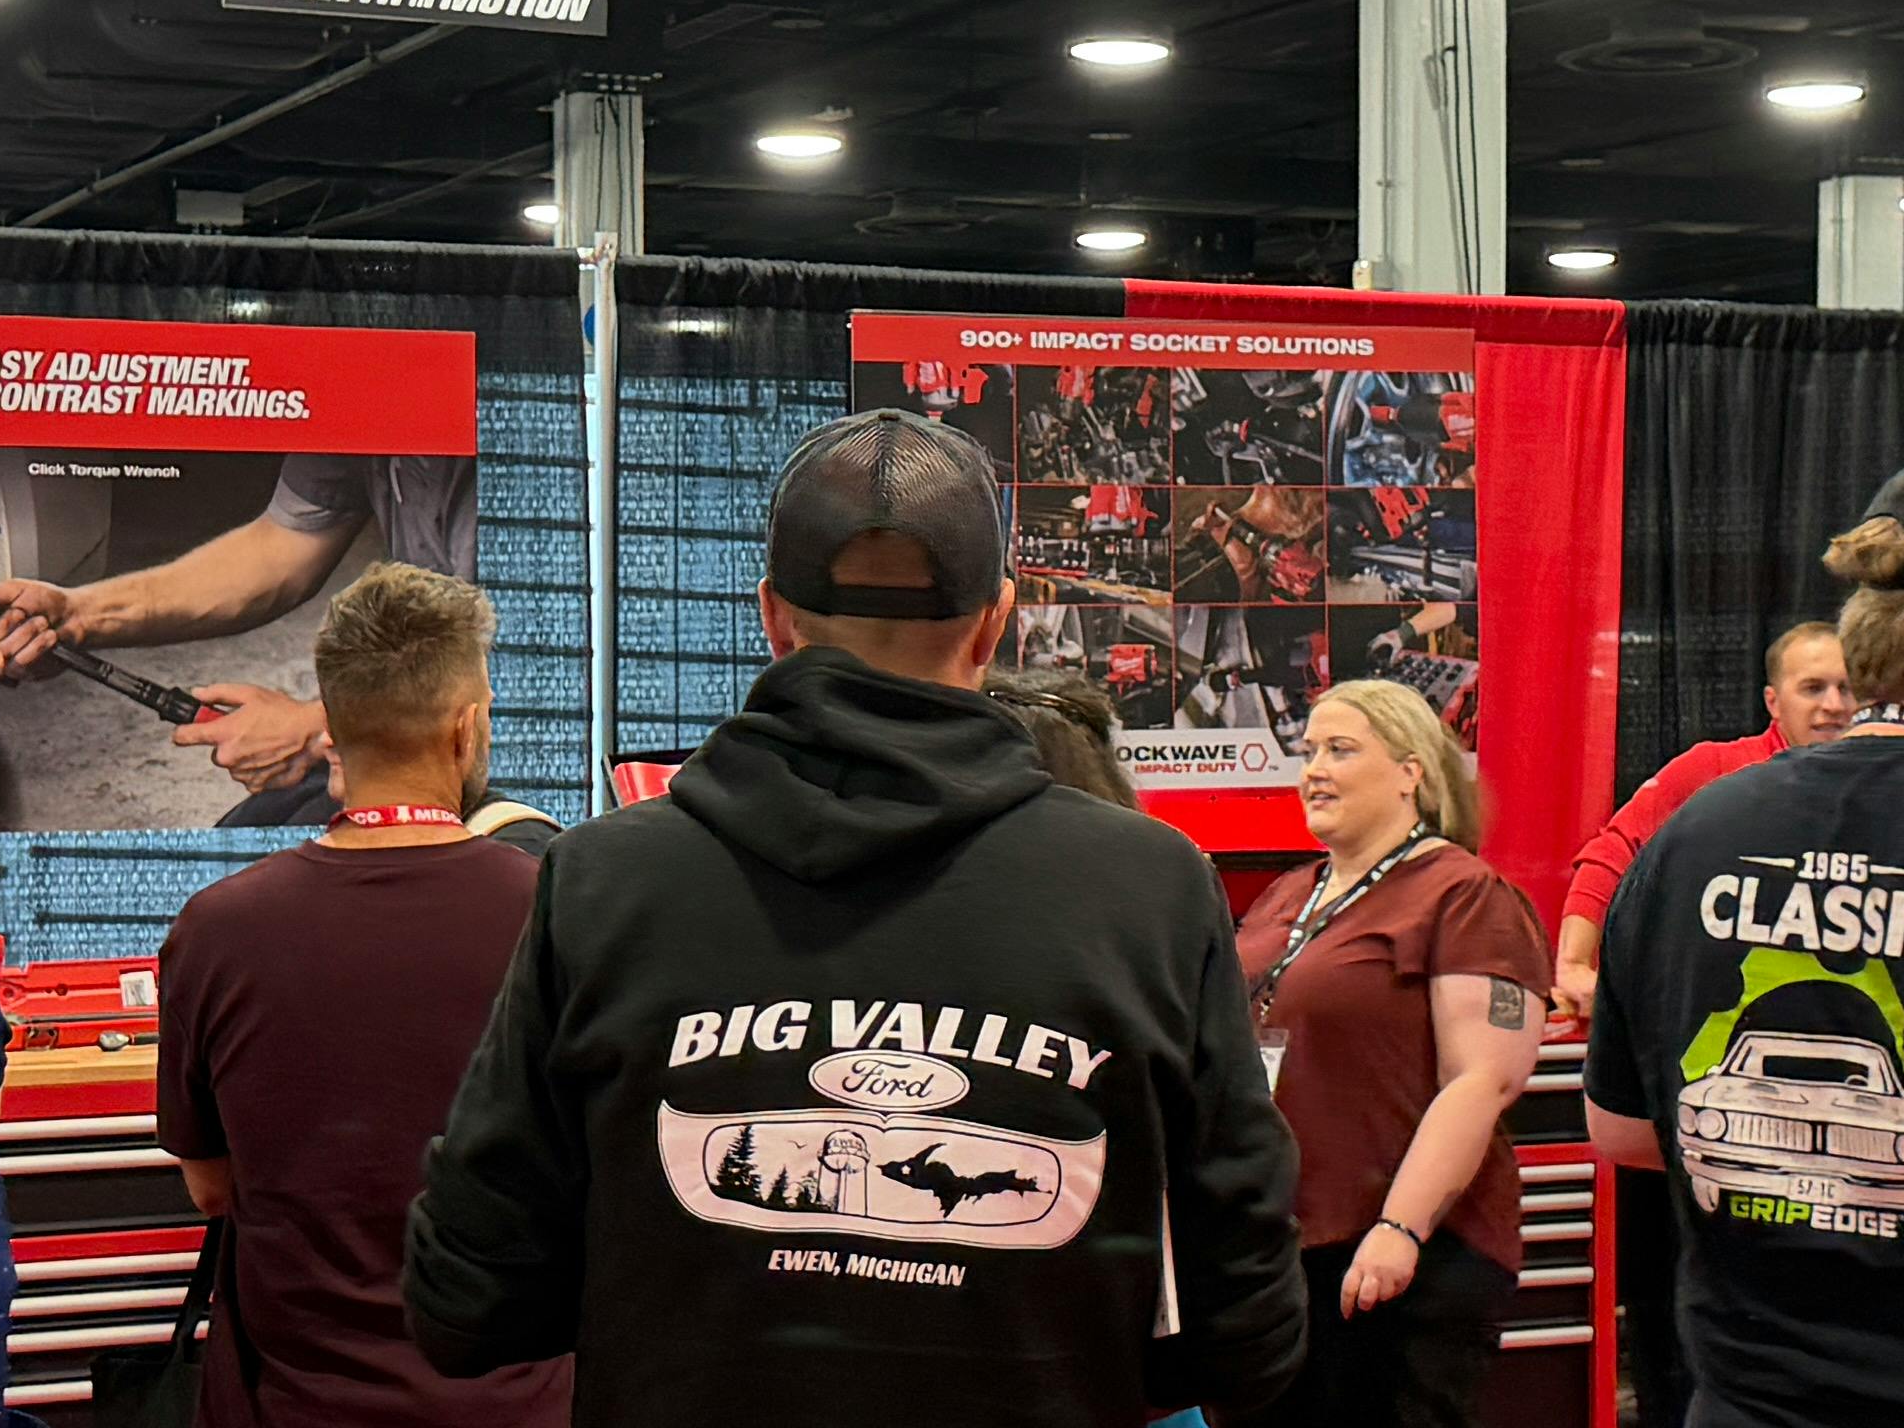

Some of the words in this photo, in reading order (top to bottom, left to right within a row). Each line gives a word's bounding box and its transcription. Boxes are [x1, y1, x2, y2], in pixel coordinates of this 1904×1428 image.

[959, 329, 1023, 348] 900+
[1030, 331, 1123, 350] IMPACT
[1130, 332, 1231, 354] SOCKET
[1236, 335, 1375, 357] SOLUTIONS
[45, 351, 251, 387] ADJUSTMENT.
[146, 387, 311, 420] MARKINGS.
[28, 461, 65, 477] Click
[69, 462, 121, 479] Torque
[124, 463, 181, 479] Wrench
[1115, 744, 1237, 762] OCKWAVE
[1134, 762, 1193, 774] IMPACT
[1197, 762, 1238, 774] DUTY
[413, 808, 464, 825] MED
[1797, 851, 1869, 883] 1965
[668, 1000, 813, 1068] BIG
[831, 999, 1113, 1090] VALLEY
[842, 1058, 933, 1100] Ford
[1730, 1195, 1899, 1239] GRIPEDGE
[768, 1249, 841, 1277] EWEN,
[845, 1254, 967, 1287] MICHIGAN
